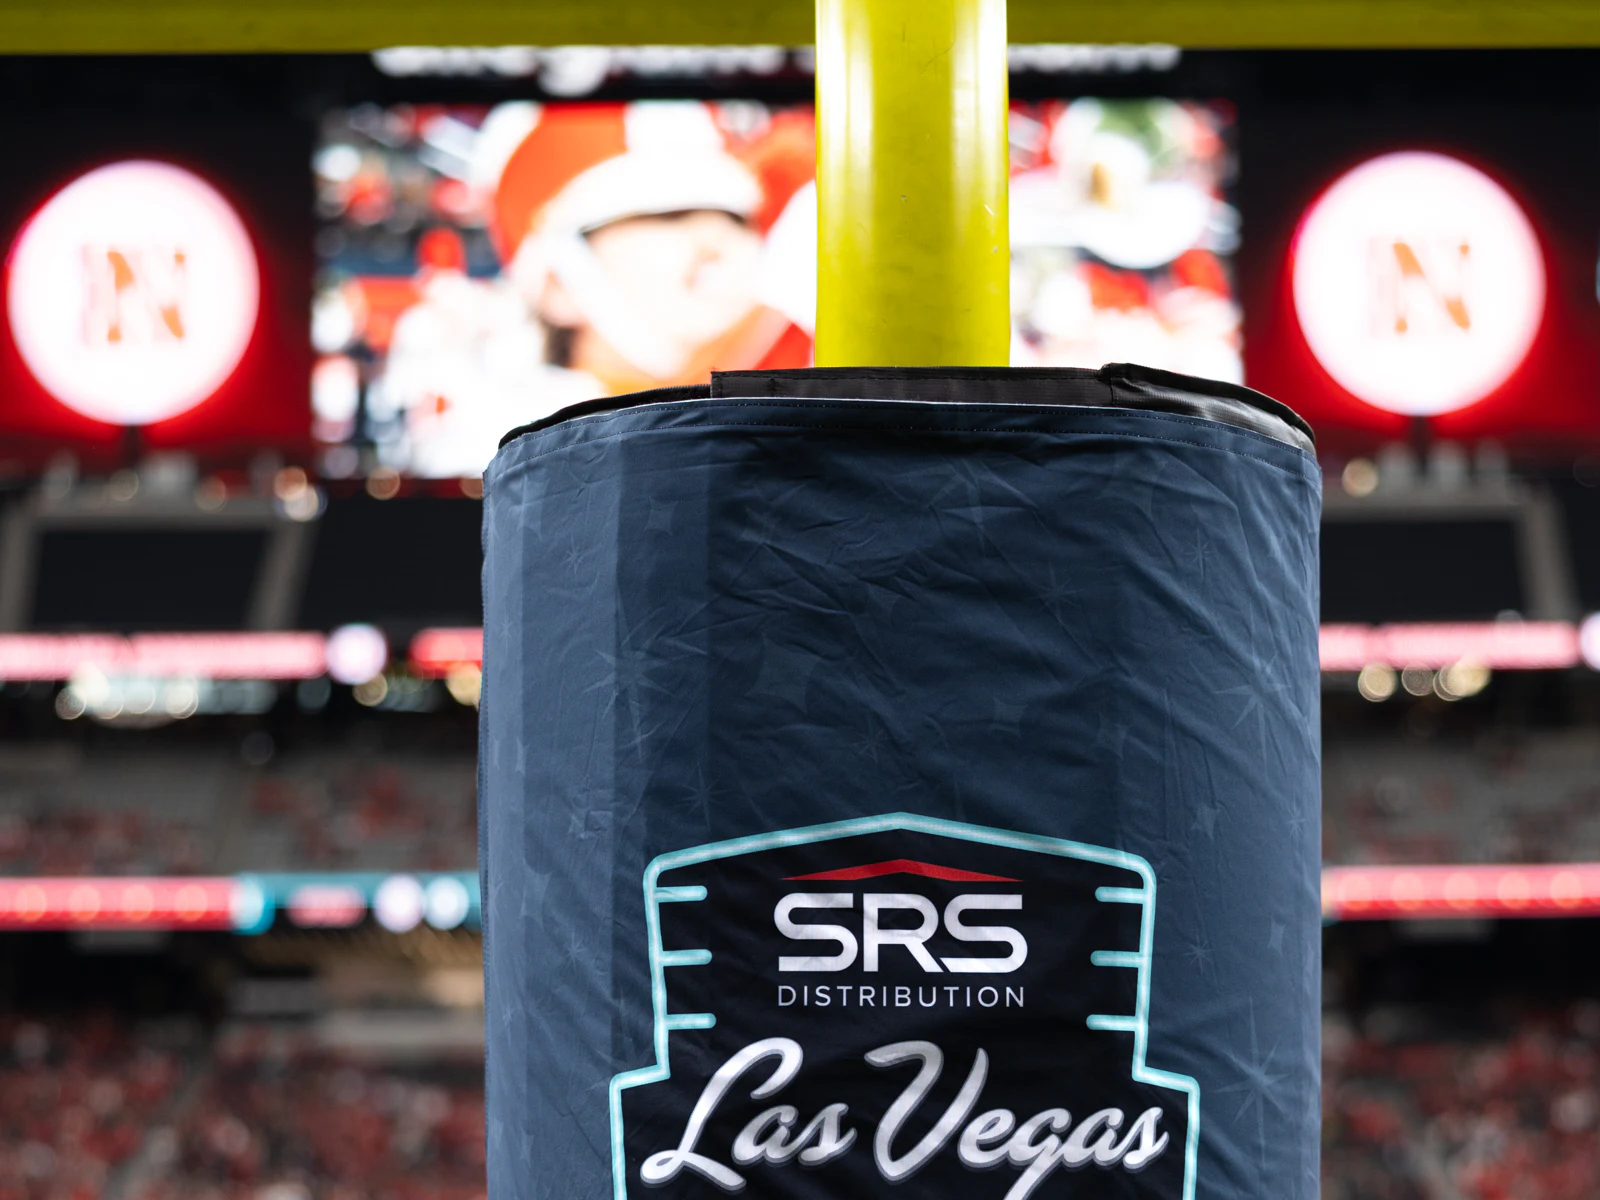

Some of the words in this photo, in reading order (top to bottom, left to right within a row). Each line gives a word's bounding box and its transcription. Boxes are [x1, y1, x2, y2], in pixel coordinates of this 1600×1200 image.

[773, 892, 1029, 974] SRS
[777, 984, 1025, 1008] DISTRIBUTION
[639, 1036, 857, 1191] Las
